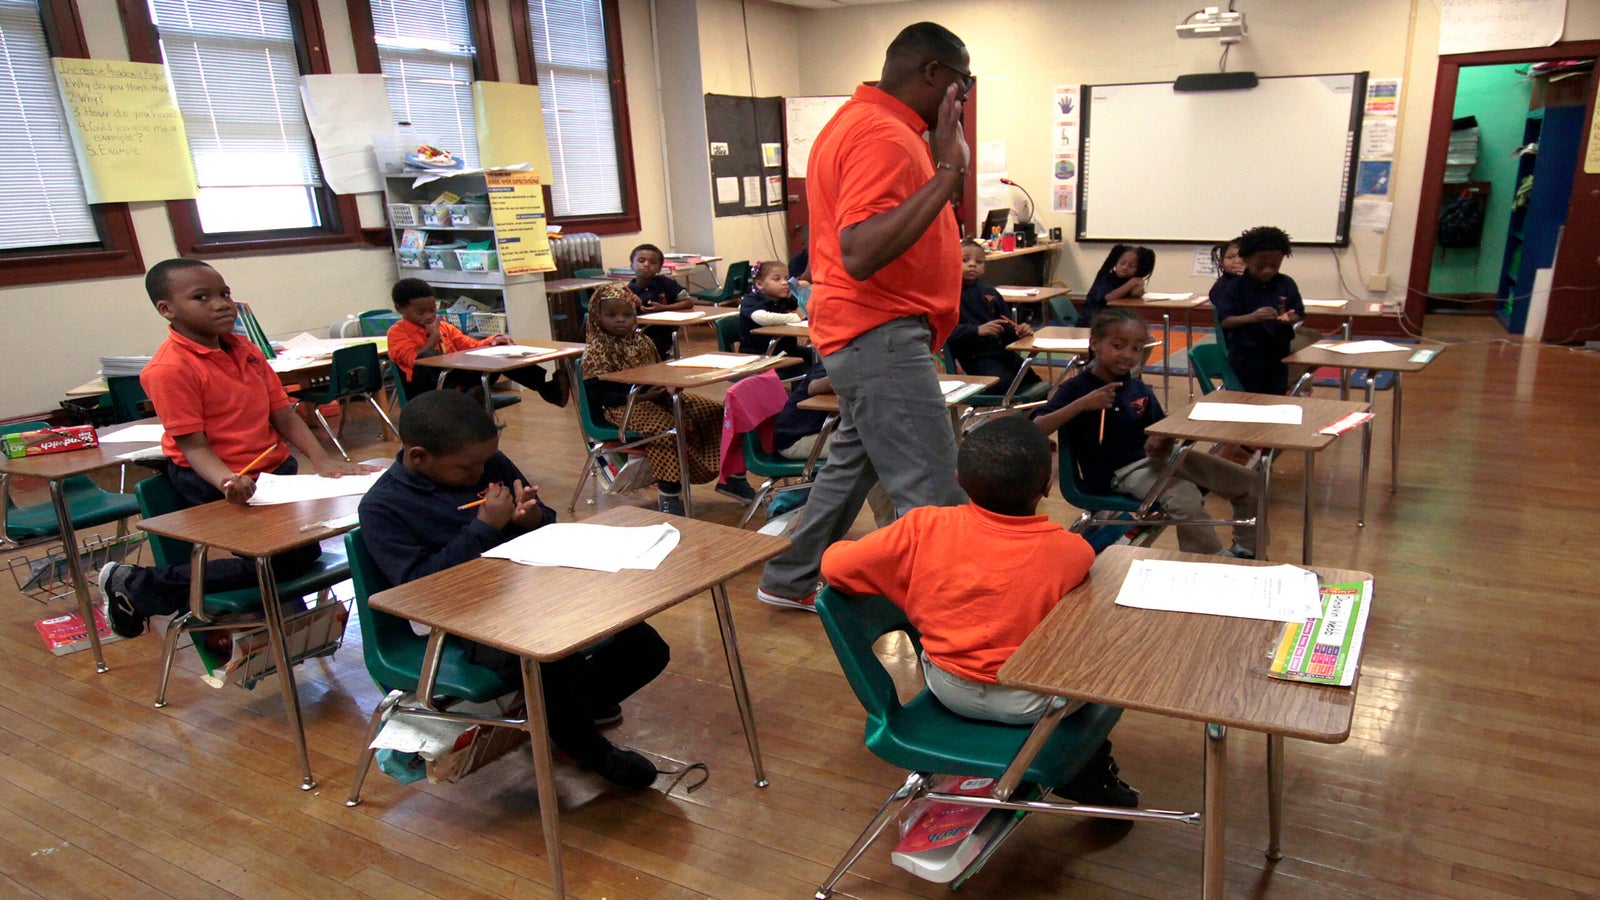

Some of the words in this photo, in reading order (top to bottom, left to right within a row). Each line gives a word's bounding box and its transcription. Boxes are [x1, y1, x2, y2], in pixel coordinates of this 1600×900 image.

[60, 59, 106, 77] Increase
[107, 83, 124, 94] you
[126, 83, 148, 92] think
[114, 108, 129, 119] do
[134, 111, 151, 121] you
[41, 435, 94, 450] Sandwich
